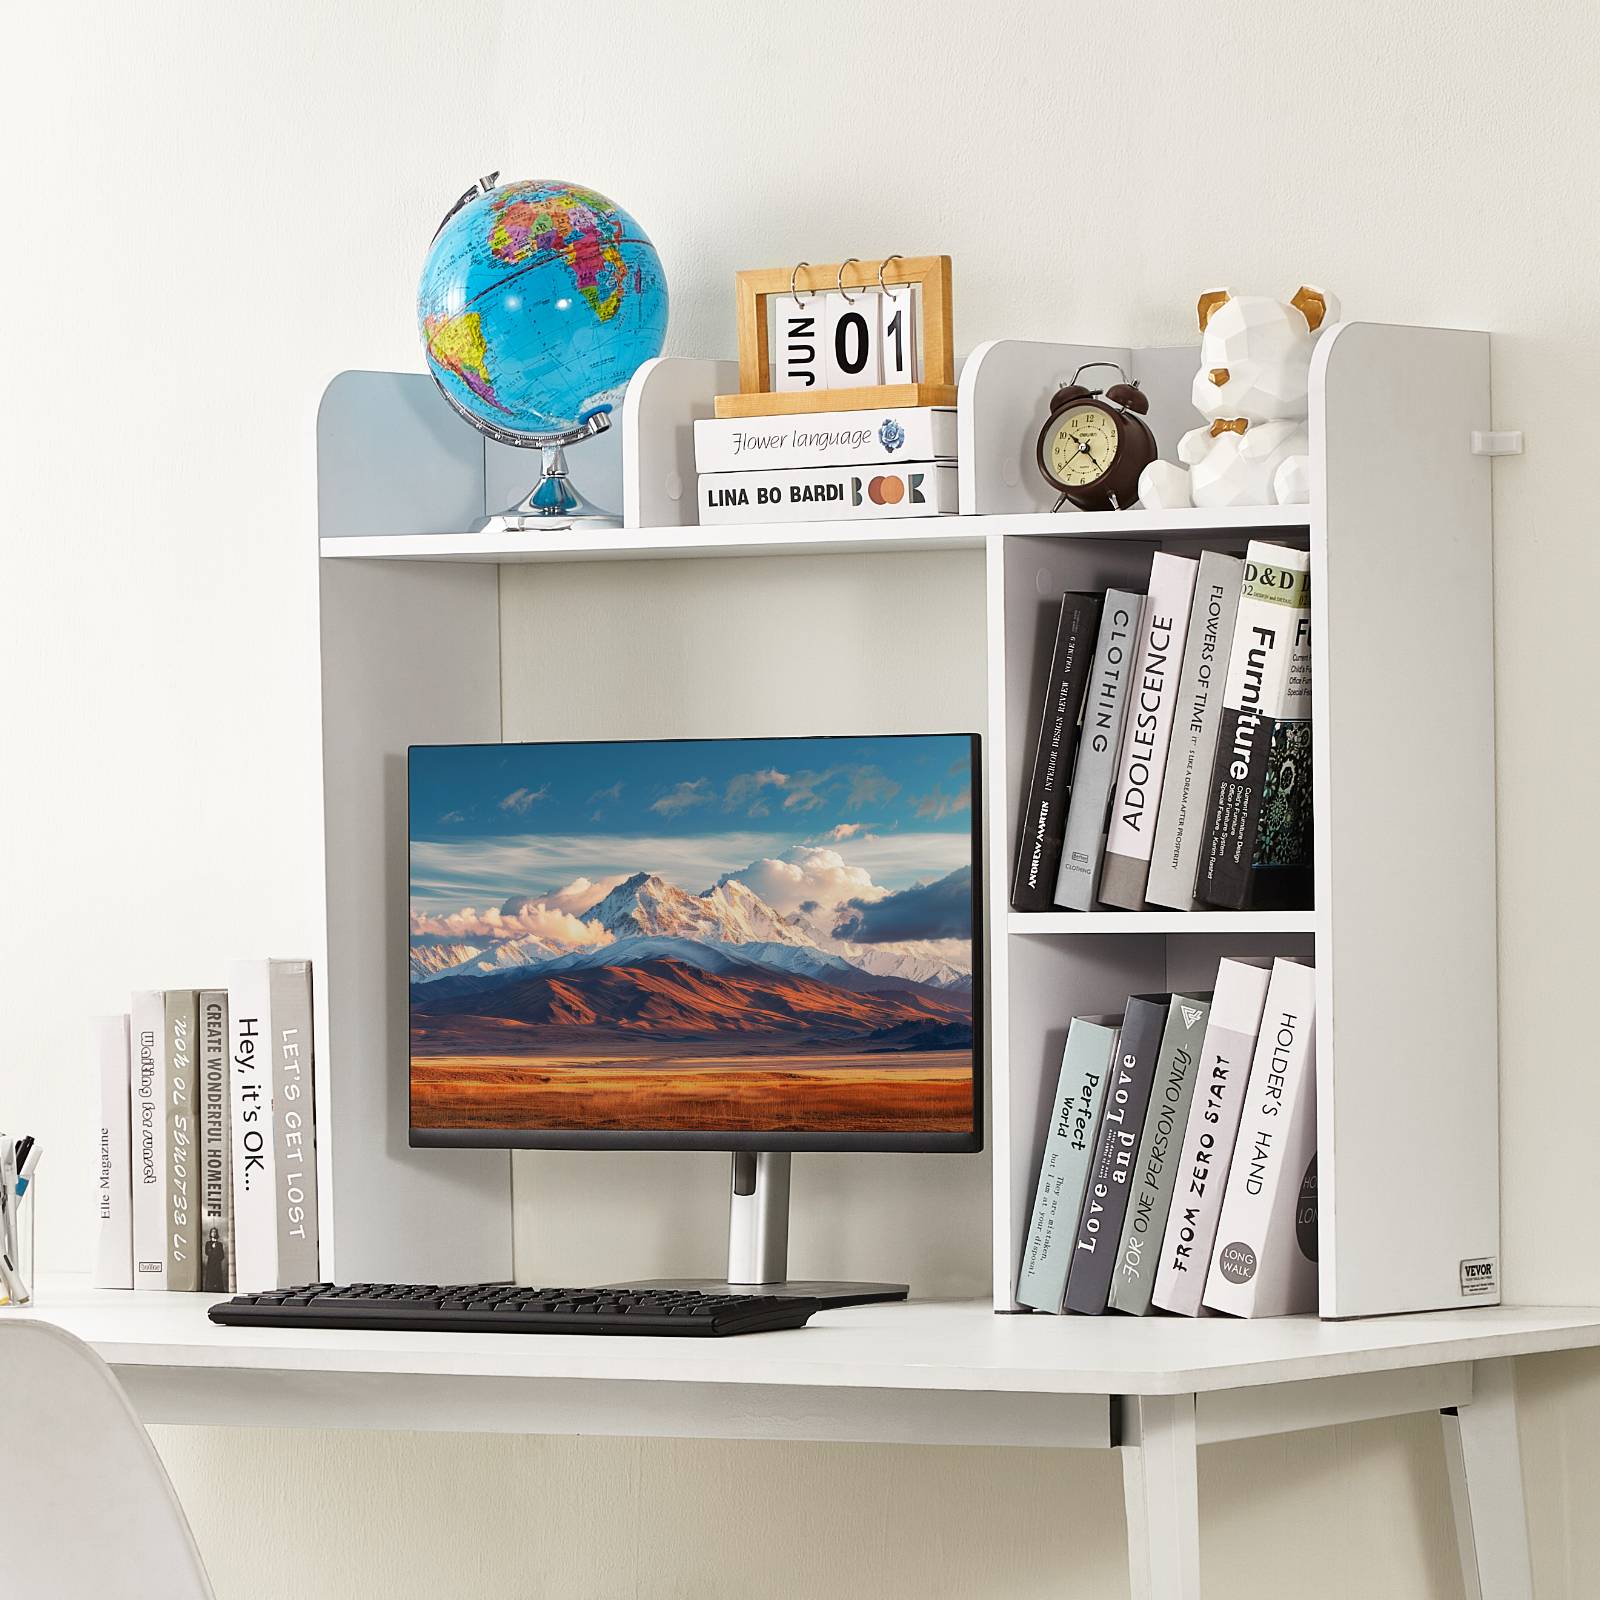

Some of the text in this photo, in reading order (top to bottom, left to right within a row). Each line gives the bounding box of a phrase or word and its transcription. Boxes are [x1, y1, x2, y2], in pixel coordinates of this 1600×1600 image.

[788, 318, 816, 386] JUN
[732, 429, 872, 455] Flower language
[1060, 431, 1067, 440] 10
[1071, 419, 1078, 427] 11
[1110, 430, 1116, 438] 2
[1054, 447, 1060, 455] 9
[708, 489, 749, 507] LINA
[757, 486, 782, 505] BO
[790, 483, 843, 503] BARDI
[1244, 563, 1294, 589] D&D
[1190, 585, 1223, 733] FLOWERS OF TIME
[1092, 609, 1129, 754] CLOTHING
[1122, 615, 1173, 832] ADOLESCENCE
[1230, 626, 1275, 780] Furniture
[1028, 841, 1042, 889] ANDREW
[1036, 800, 1049, 842] MARTIN
[1045, 750, 1058, 791] INTERIOR
[1052, 716, 1064, 748] DESIGN
[1058, 680, 1069, 713] REVIEW
[1064, 643, 1075, 673] VOLUME
[1181, 777, 1191, 803] DREAM
[1219, 781, 1227, 806] Special
[1230, 785, 1243, 836] Child's Furniture
[1179, 806, 1187, 826] AFTER
[1214, 806, 1224, 831] Feature
[1219, 783, 1235, 856] Office Furniture System
[1233, 787, 1252, 864] Current Furniture Design
[234, 1018, 258, 1074] Hey,
[140, 1031, 157, 1184] Waiting for sunset
[206, 1003, 222, 1217] CREATE WONDERFUL HOMELIFE
[240, 1084, 262, 1123] it's
[1057, 1097, 1075, 1138] World
[1071, 1072, 1100, 1150] Perfect
[1246, 1013, 1298, 1195] HOLDER'S HAND
[173, 1015, 191, 1262] IT BELONGS TO YOU.
[281, 1028, 306, 1239] LET'S GET LOST
[1077, 1053, 1136, 1254] Love and Love
[100, 1128, 110, 1219] Elle Magazine
[1049, 1153, 1059, 1168] but
[1133, 1192, 1155, 1233] ONE
[1144, 1105, 1176, 1190] PERSON
[1173, 1055, 1230, 1272] FROM ZERO START
[1042, 1196, 1048, 1207] at
[1044, 1182, 1051, 1193] am
[1054, 1177, 1064, 1196] They
[1036, 1211, 1045, 1232] your
[1223, 1261, 1252, 1278] WALK.
[1224, 1248, 1254, 1265] LONG
[1464, 1263, 1492, 1277] VEVOR
